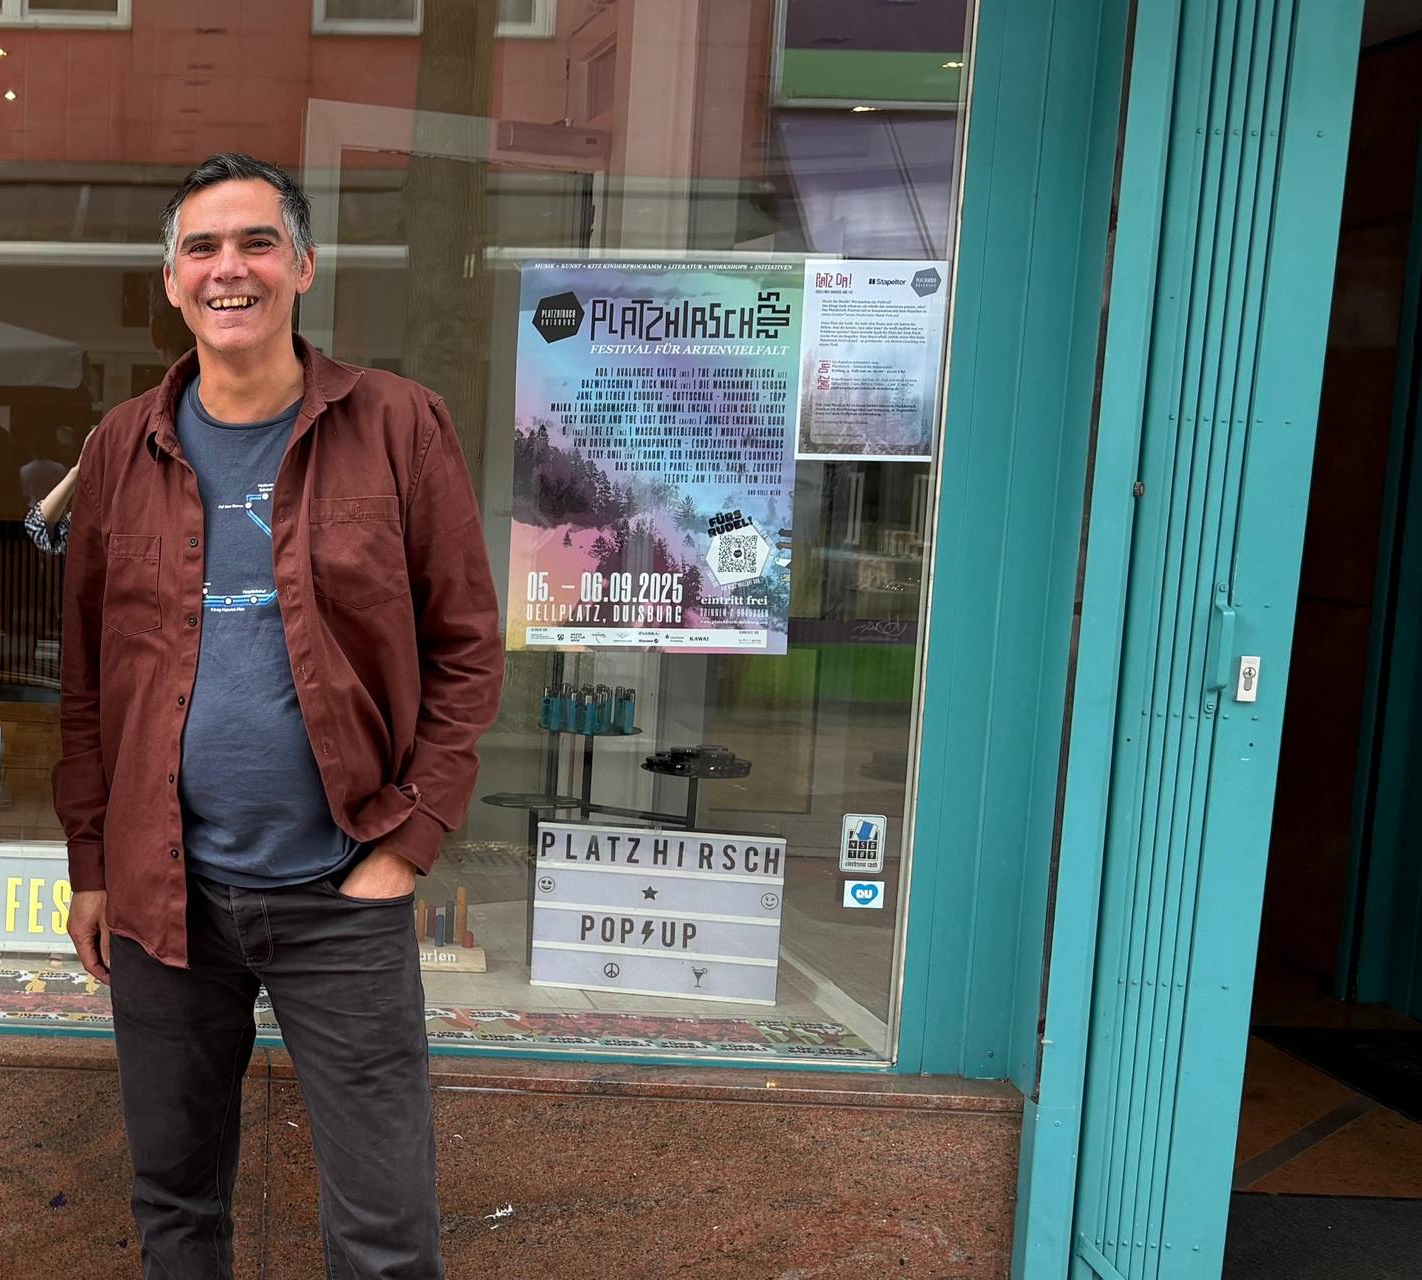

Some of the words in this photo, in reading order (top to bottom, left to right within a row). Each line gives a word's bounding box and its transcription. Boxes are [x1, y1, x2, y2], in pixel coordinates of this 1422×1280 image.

[876, 278, 906, 286] Stapeltor
[590, 300, 754, 341] PLATZHIRSCH
[756, 292, 790, 339] 2025
[590, 344, 654, 355] FESTIVAL
[656, 343, 681, 355] FÜR
[683, 345, 789, 356] ARTENVIELFALT
[713, 368, 743, 377] JACKSON
[746, 368, 775, 377] POLLOCK
[660, 380, 677, 389] MOVE
[576, 392, 592, 401] JANE
[657, 403, 684, 413] MINIMAL
[640, 415, 656, 425] LOST
[708, 509, 742, 527] FÜRS
[707, 516, 754, 538] RUDEL!
[527, 572, 554, 603] 05.
[581, 572, 683, 604] 06.09.2025
[700, 596, 744, 605] eintritt
[746, 595, 768, 605] frei
[527, 604, 607, 624] DELLPLATZ,
[613, 604, 682, 623] DUISBURG
[541, 831, 780, 875] PLATZHIRSCH
[856, 889, 873, 899] DU
[581, 914, 634, 945] POP
[662, 922, 697, 949] UP
